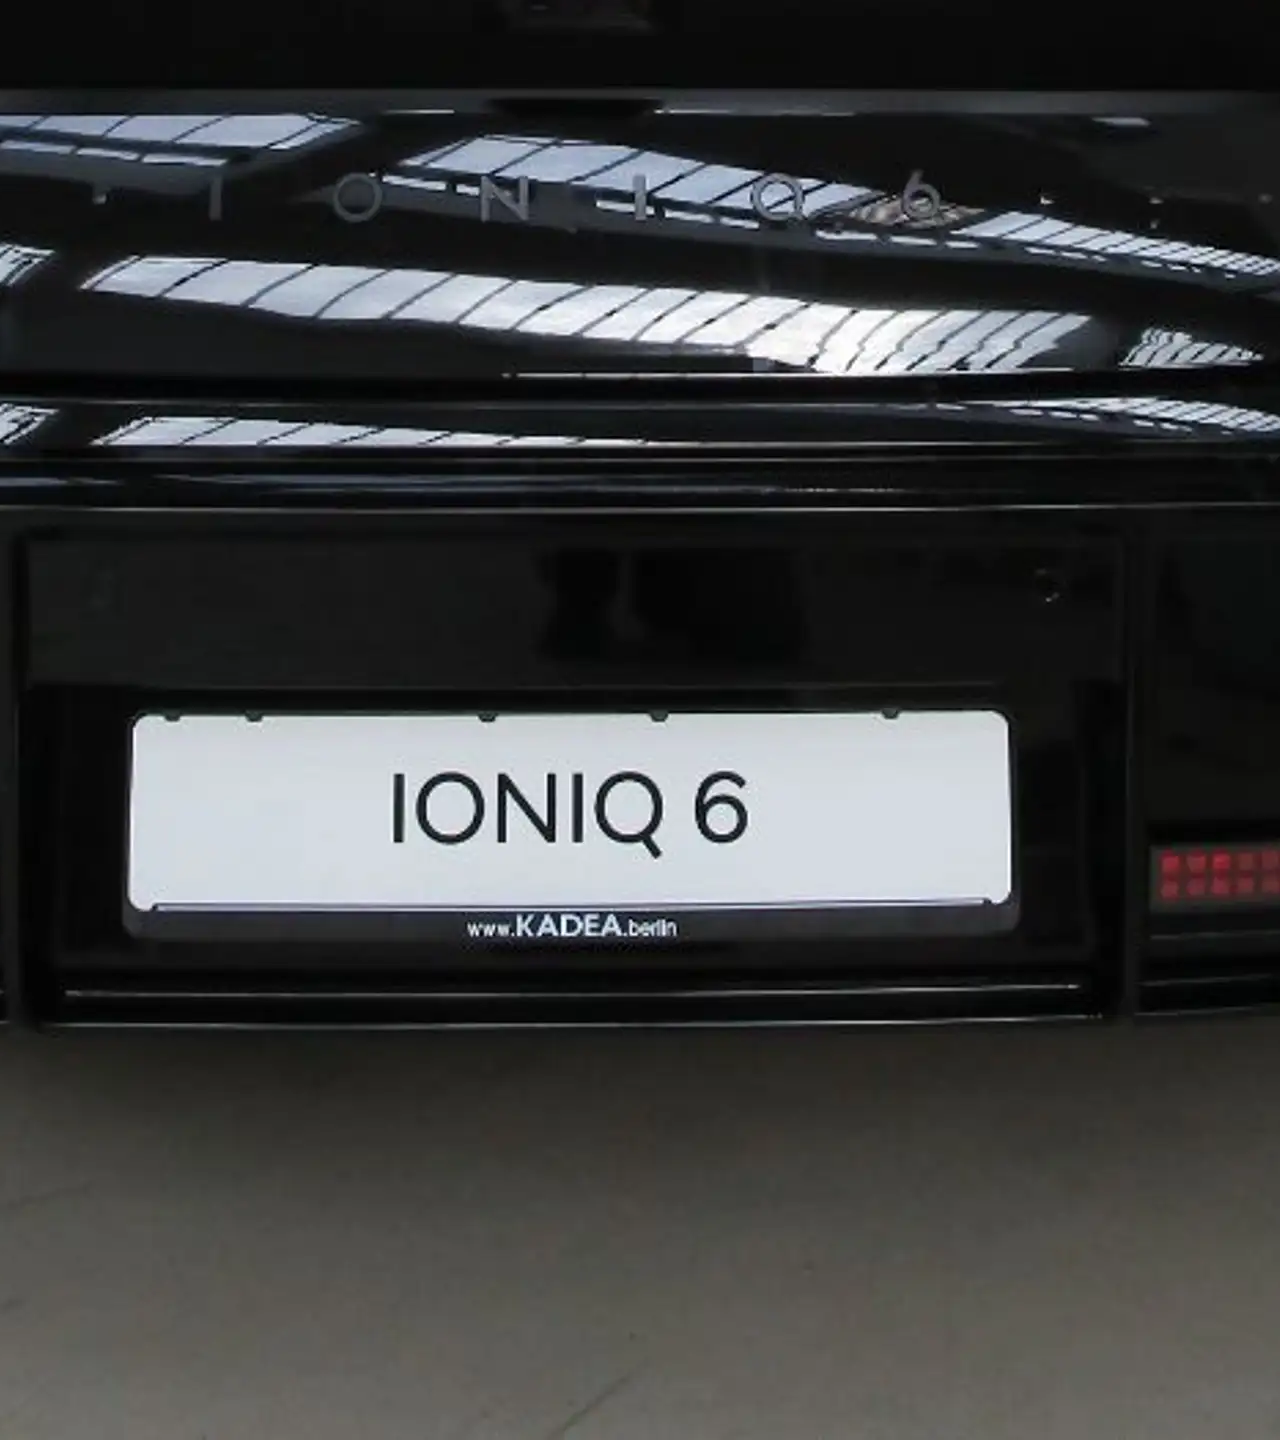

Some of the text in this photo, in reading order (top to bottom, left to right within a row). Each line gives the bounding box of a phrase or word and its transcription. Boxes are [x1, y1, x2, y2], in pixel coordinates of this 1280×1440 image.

[393, 771, 749, 858] IONIQ 6
[466, 914, 678, 938] www.KADEA.berlin
